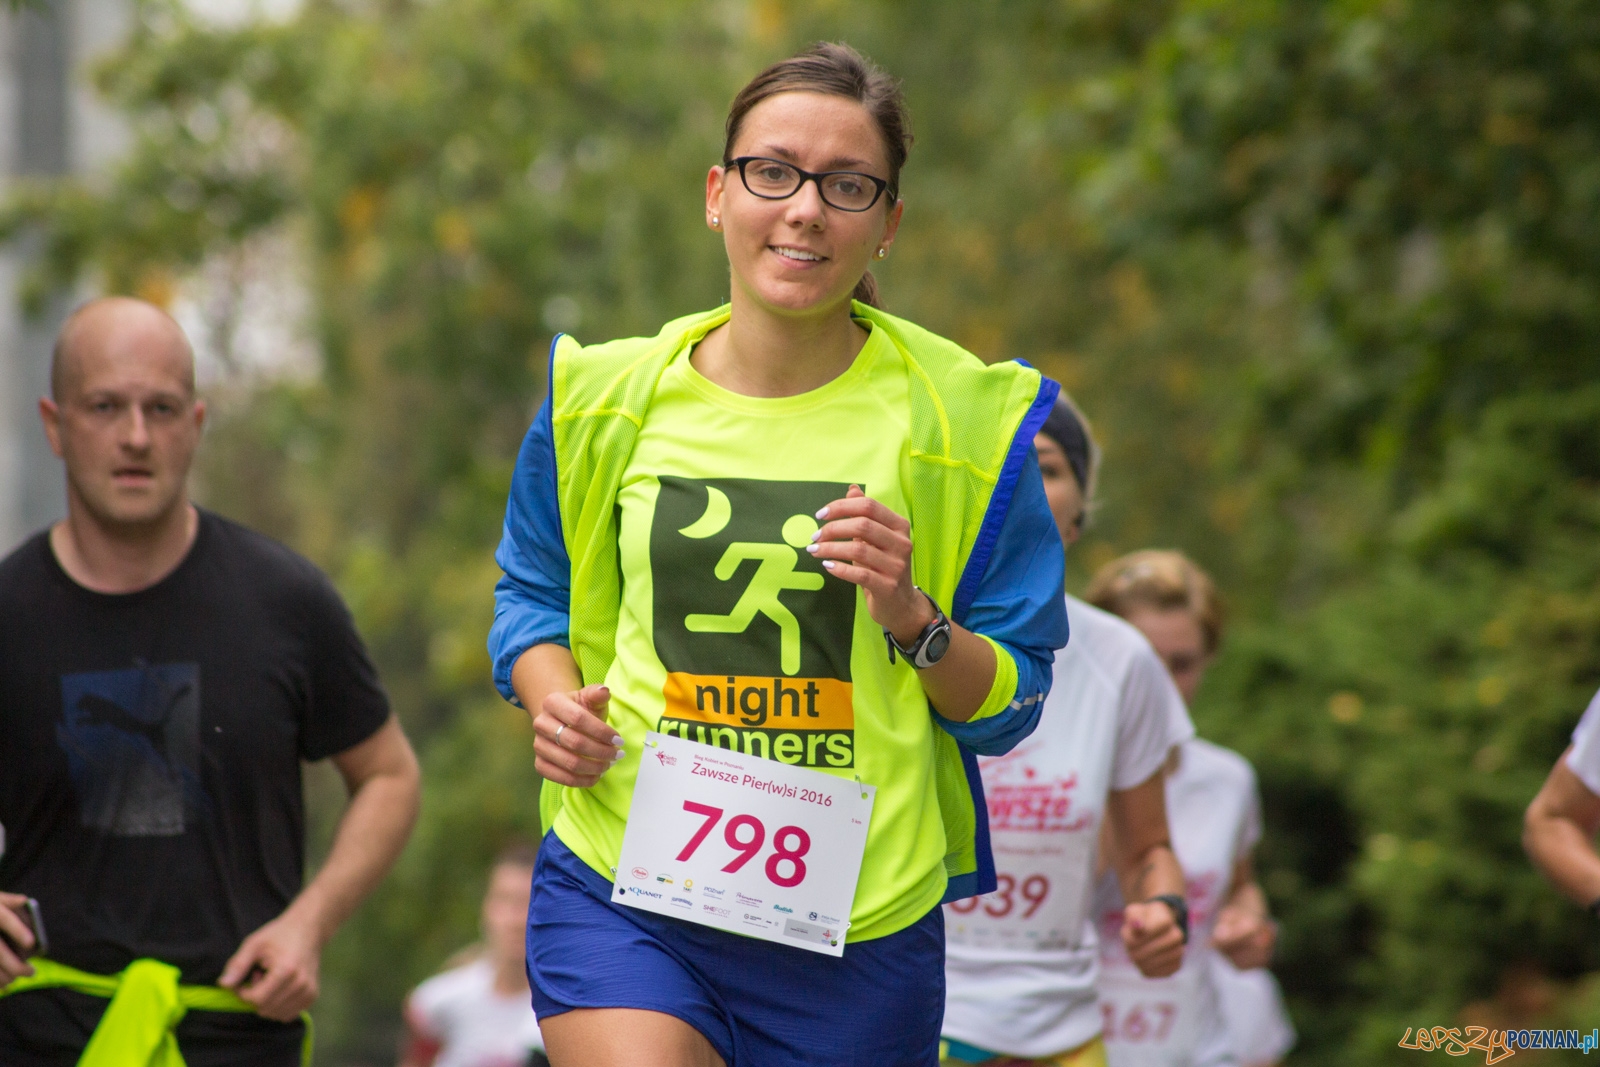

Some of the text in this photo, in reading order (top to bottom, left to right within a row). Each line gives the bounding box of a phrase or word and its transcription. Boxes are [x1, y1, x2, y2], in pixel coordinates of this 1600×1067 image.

[695, 676, 820, 726] night
[691, 762, 833, 807] Zawsze Pier(w)si 2016
[675, 800, 811, 888] 798
